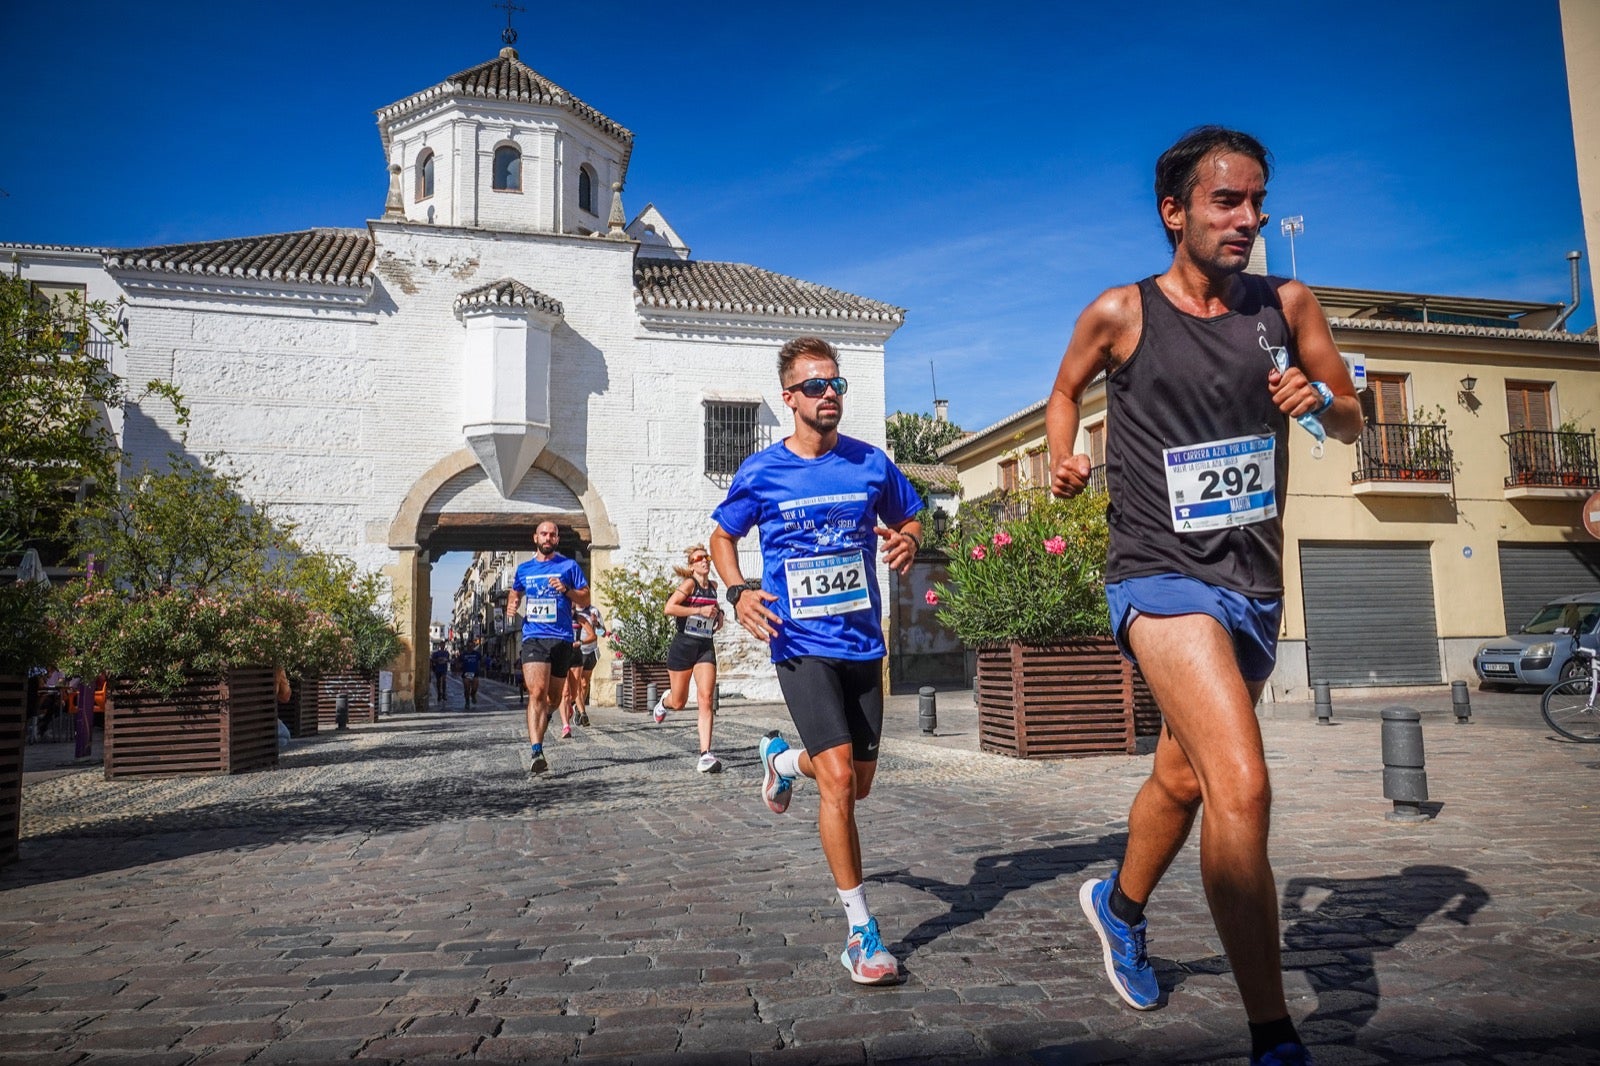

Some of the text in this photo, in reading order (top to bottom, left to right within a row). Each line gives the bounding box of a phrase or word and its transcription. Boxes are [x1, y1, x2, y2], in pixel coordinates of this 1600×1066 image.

[1173, 455, 1181, 463] VI
[1183, 450, 1210, 461] CARRERA
[1213, 448, 1228, 457] AZUL
[1230, 445, 1240, 454] POR
[1198, 462, 1263, 501] 292
[798, 508, 806, 518] LA
[801, 569, 861, 596] 1342
[532, 606, 549, 614] 471
[696, 619, 707, 629] 81
